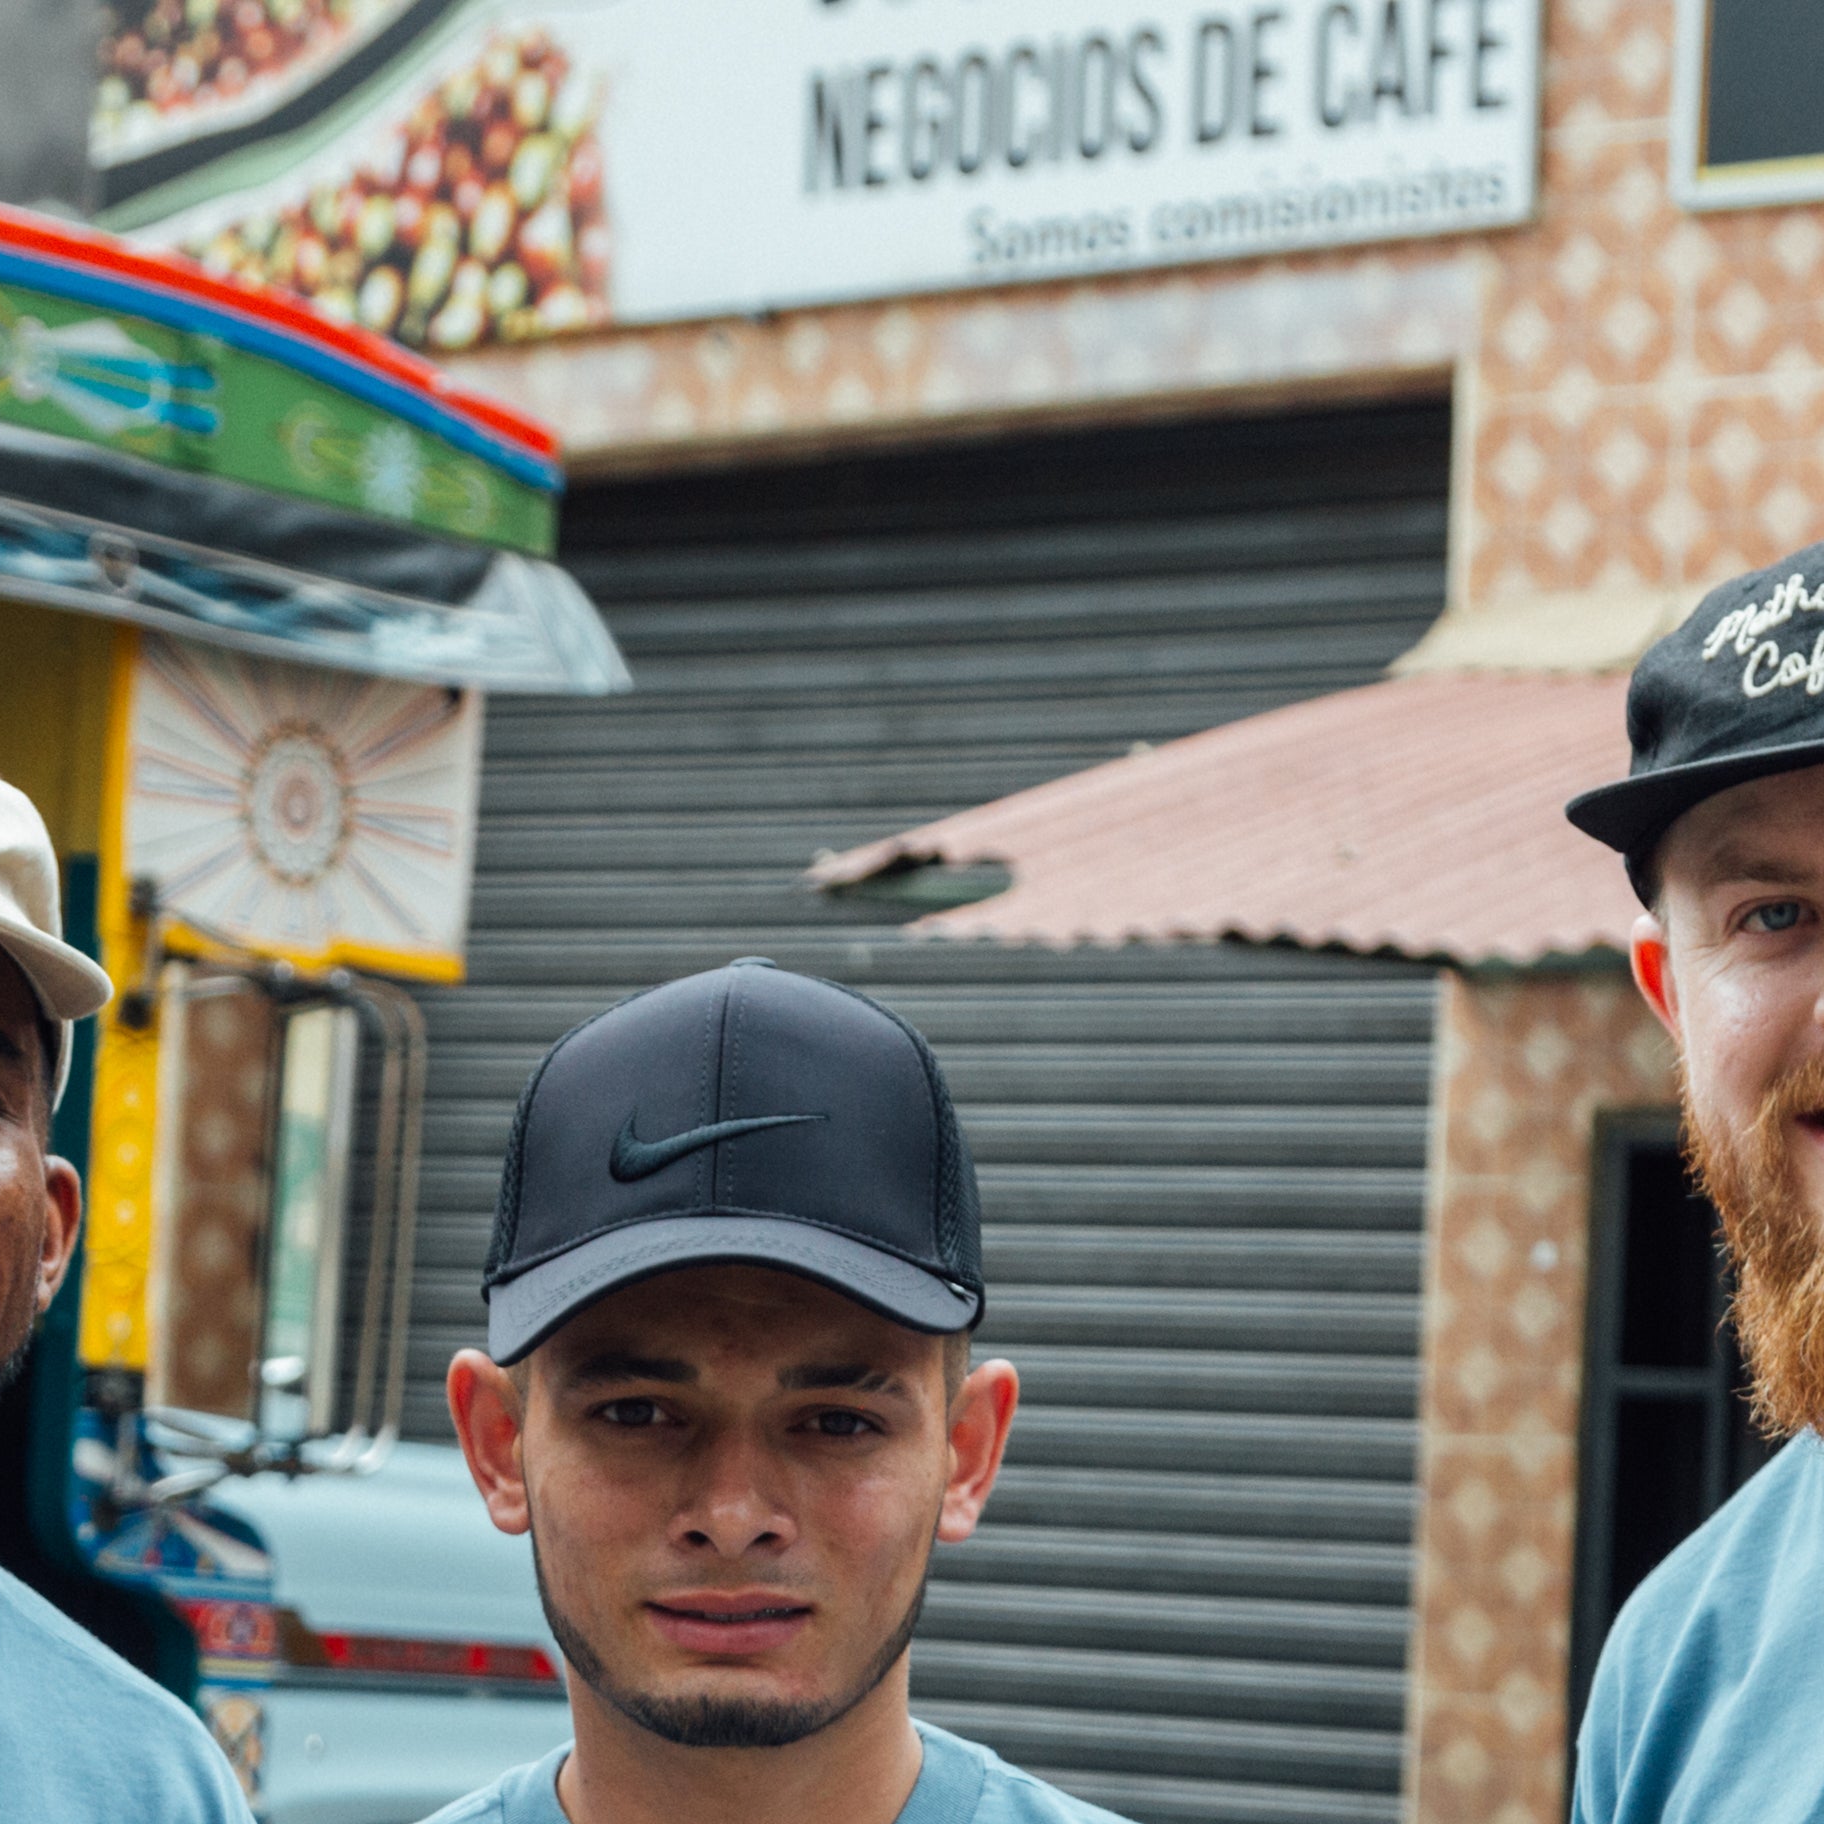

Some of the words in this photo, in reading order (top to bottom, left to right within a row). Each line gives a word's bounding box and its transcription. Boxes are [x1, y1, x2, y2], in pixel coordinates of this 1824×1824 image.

[803, 28, 1164, 196] NEGOCIOS
[1192, 12, 1282, 146] DE
[970, 204, 1132, 263] Somos
[1149, 158, 1509, 243] comisionistas
